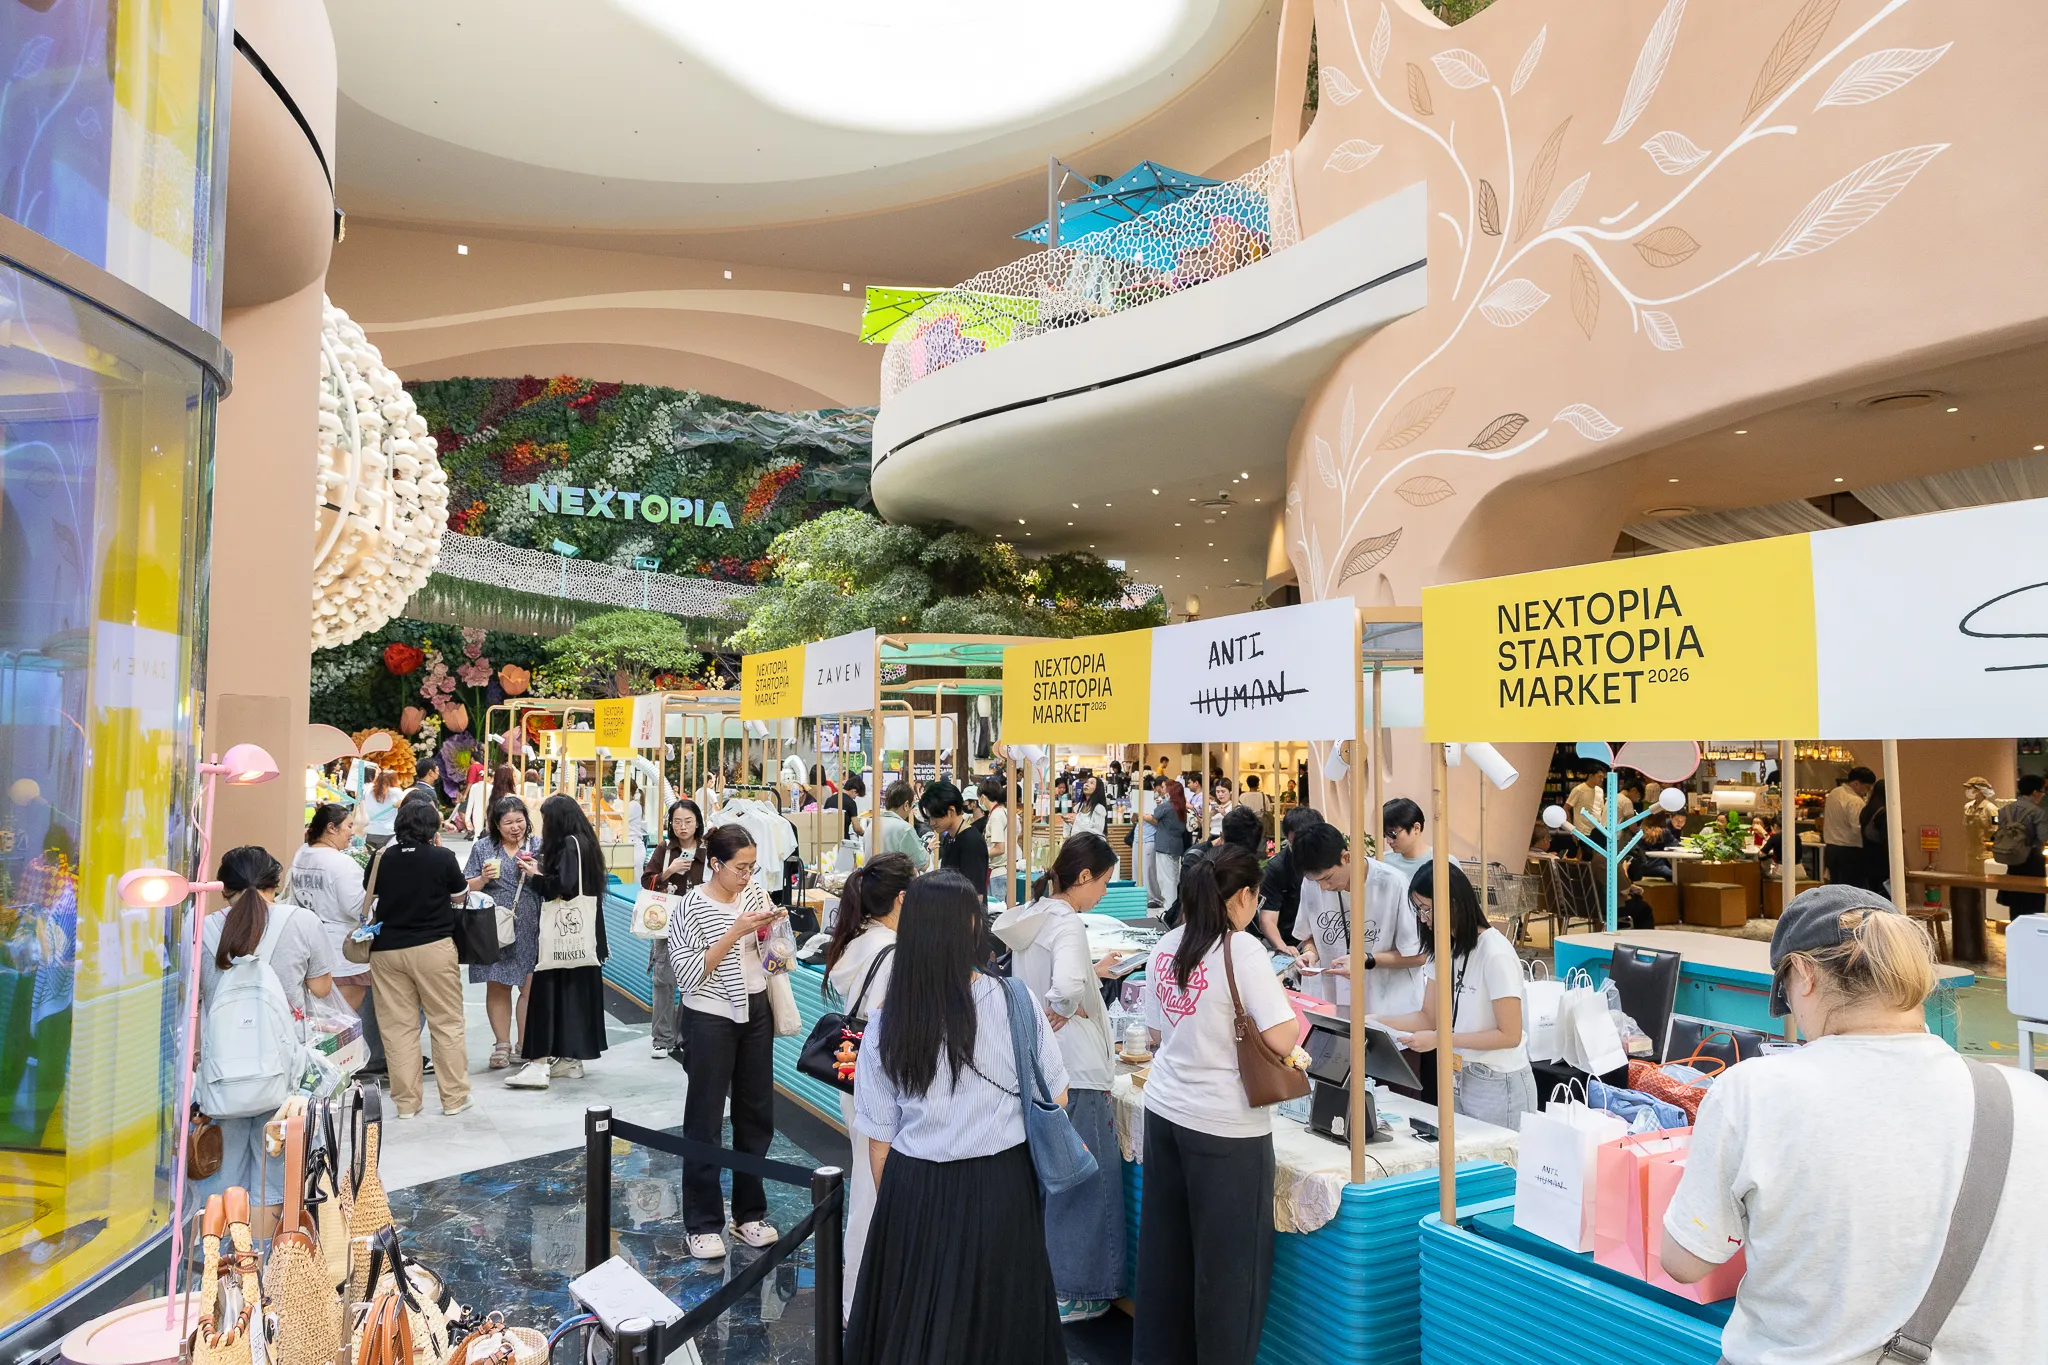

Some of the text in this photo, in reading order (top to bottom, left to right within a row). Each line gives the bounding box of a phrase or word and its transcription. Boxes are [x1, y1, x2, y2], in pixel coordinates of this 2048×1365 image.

[529, 483, 734, 529] NEXTOPIA
[1497, 585, 1682, 635] NEXTOPIA
[1208, 632, 1264, 669] ANTI
[1497, 625, 1704, 672] STARTOPIA
[756, 660, 788, 676] NEXTOPIA
[817, 662, 861, 686] ZAVEN
[1034, 653, 1106, 678] NEXTOPIA
[755, 675, 790, 692] STARTOPIA
[1033, 677, 1113, 702] STARTOPIA
[1191, 670, 1308, 717] HUMAN
[1498, 667, 1689, 709] MARKET 2026
[754, 692, 780, 706] MARKET
[1032, 703, 1090, 724] MARKET
[1156, 983, 1192, 1010] Made
[1541, 1165, 1559, 1176] ANTI
